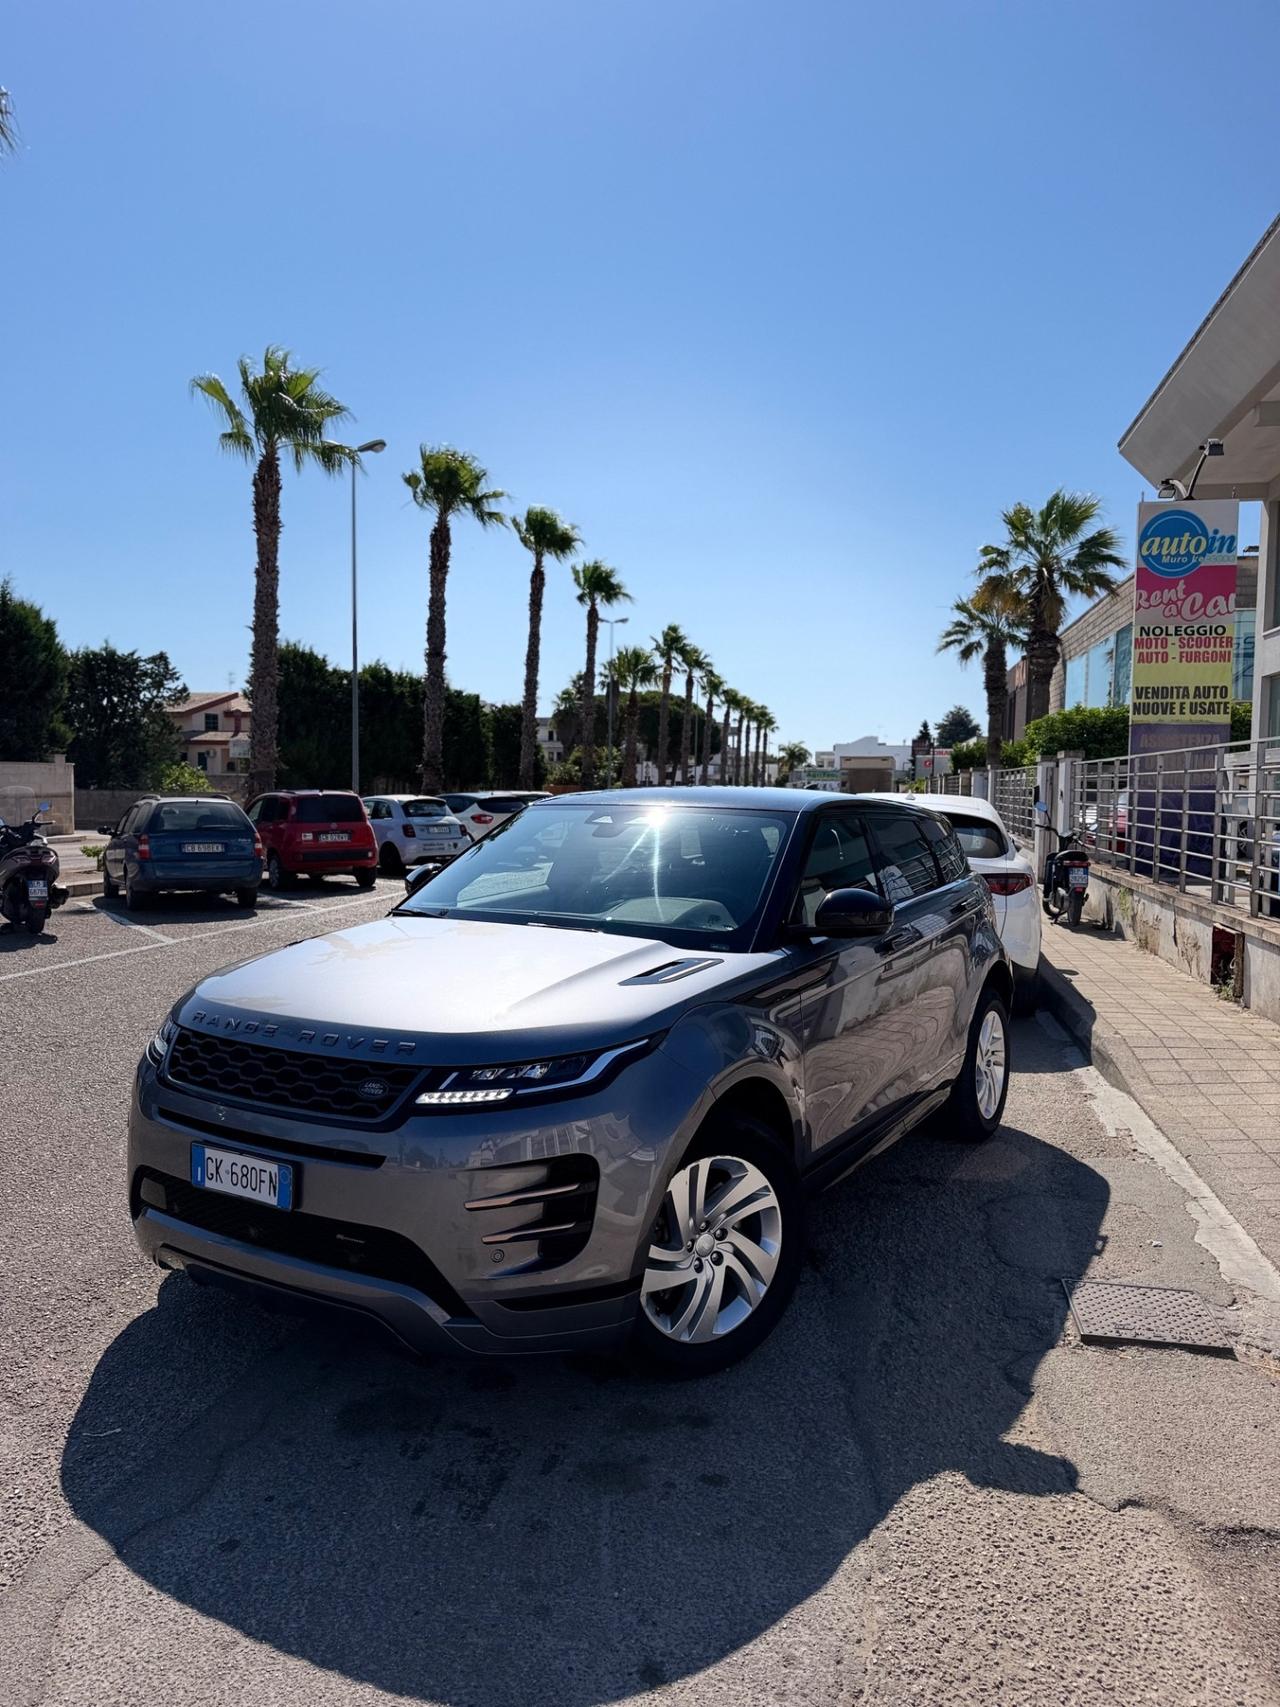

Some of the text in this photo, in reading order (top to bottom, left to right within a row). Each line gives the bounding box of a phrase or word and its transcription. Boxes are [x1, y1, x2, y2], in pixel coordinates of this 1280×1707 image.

[1161, 555, 1188, 563] Muro
[1135, 580, 1186, 609] Rent
[1140, 625, 1226, 637] NOLEGGIO
[1134, 637, 1168, 649] MOTO
[1178, 636, 1233, 649] SCOOTER
[1137, 651, 1169, 664] AUTO
[1179, 651, 1232, 663] FURGONI
[1135, 685, 1228, 699] VENDITA AUTO
[1133, 701, 1230, 715] NUOVE E USATE
[192, 1010, 417, 1056] RANGE ROVER
[205, 1156, 223, 1185] GK
[230, 1161, 278, 1199] 680FN
